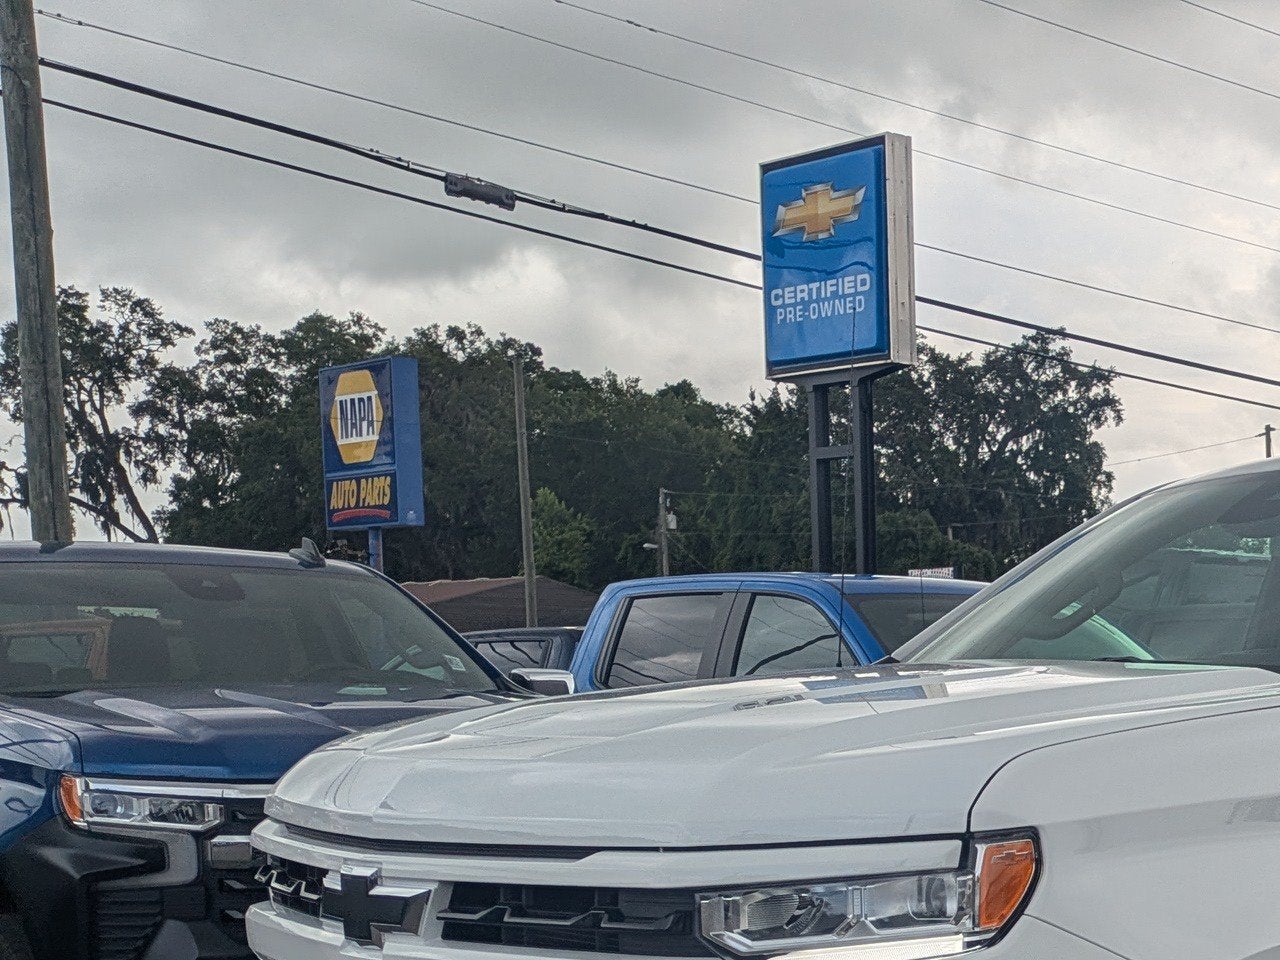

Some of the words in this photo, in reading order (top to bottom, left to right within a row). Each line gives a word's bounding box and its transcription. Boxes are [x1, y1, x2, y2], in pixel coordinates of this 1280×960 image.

[770, 273, 871, 306] CERTIFIED
[776, 295, 865, 325] PRE-OWNED
[338, 395, 375, 440] NAPA
[330, 478, 357, 510] AUTO
[359, 476, 391, 508] PARTS
